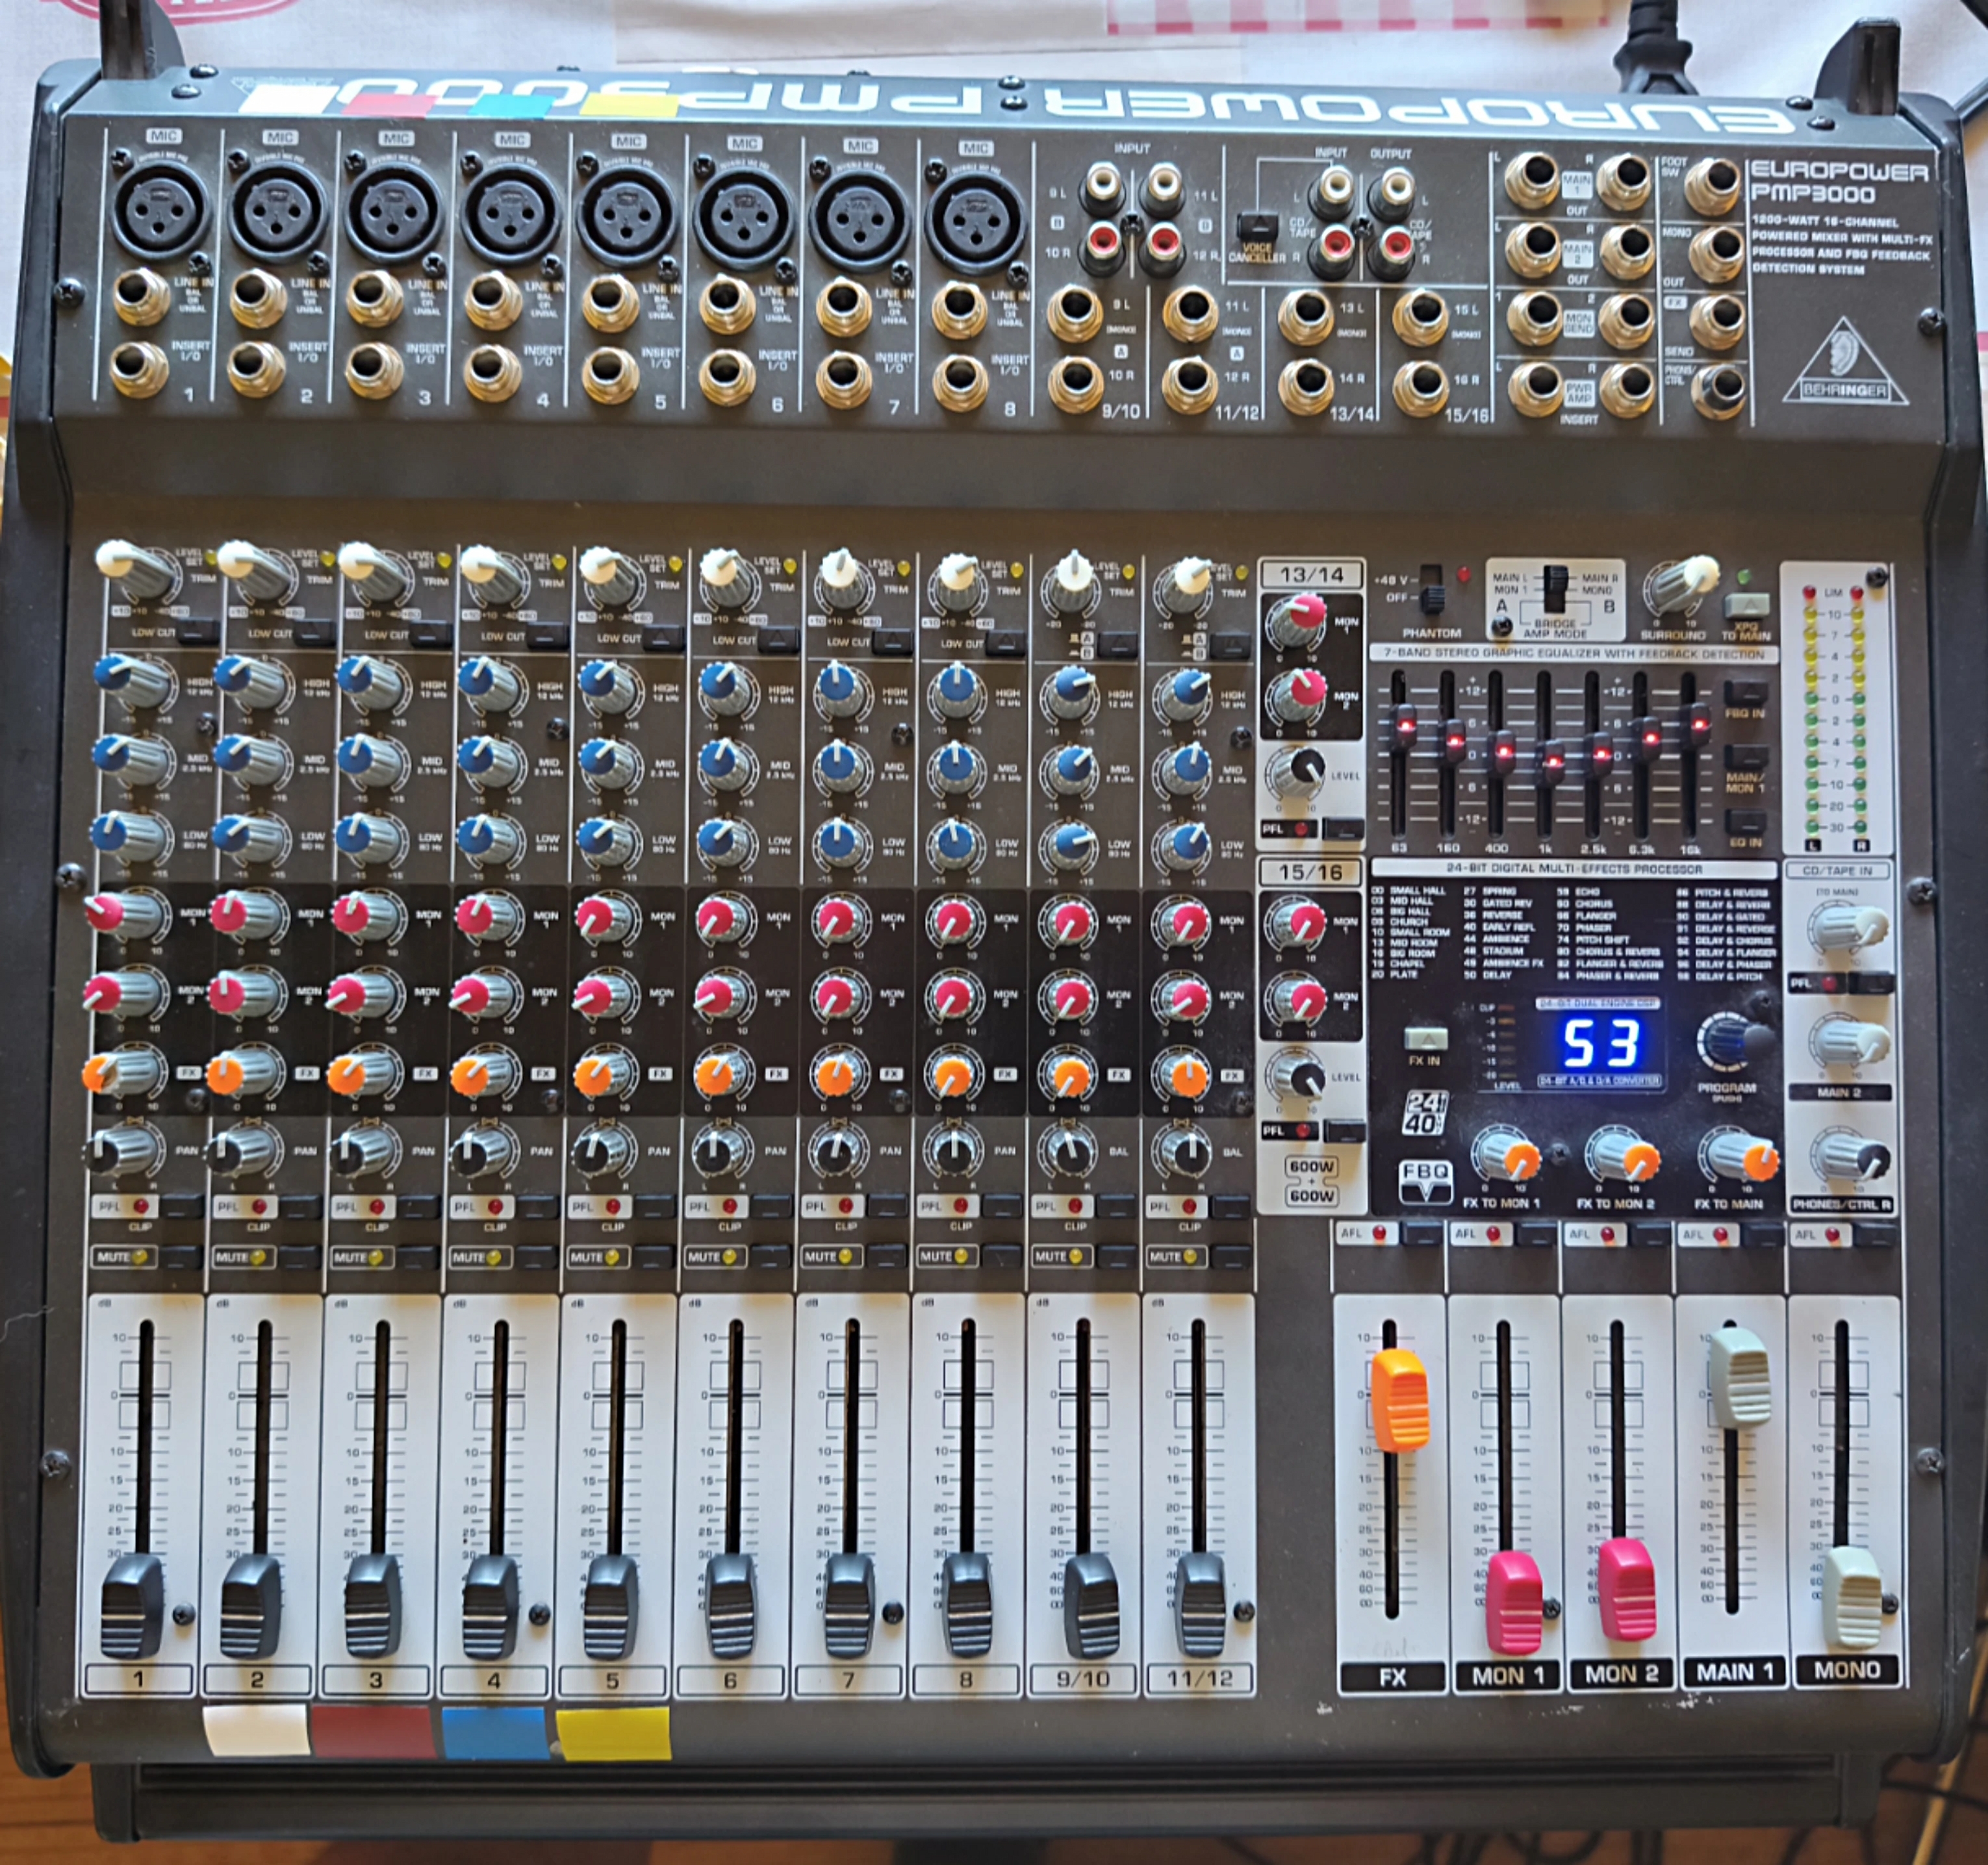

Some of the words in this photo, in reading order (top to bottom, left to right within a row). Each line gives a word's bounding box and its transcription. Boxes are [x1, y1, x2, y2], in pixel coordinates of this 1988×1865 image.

[1045, 89, 1796, 134] EUROPOWER
[151, 130, 177, 142] MIC
[268, 131, 294, 144] MIC
[385, 133, 409, 145] MIC
[500, 135, 526, 146] MIC
[617, 136, 642, 147] MIC
[732, 138, 758, 149] MIC
[848, 140, 873, 151] MIC
[964, 143, 989, 154] MIC
[1115, 144, 1151, 155] INPUT
[1315, 147, 1347, 159] INPUT
[1371, 149, 1412, 159] OUTPUT
[1661, 157, 1687, 166] FOOT
[1752, 160, 1929, 182] EUROPOWER
[1752, 184, 1875, 203] PMP3000
[1567, 207, 1588, 216] OUT
[1753, 214, 1819, 225] 1200-WATT
[1824, 216, 1899, 227] 16-CHANNEL
[1663, 229, 1691, 237] MONO
[1753, 231, 1808, 242] POWERED
[1812, 233, 1848, 242] MIXER
[1852, 234, 1877, 243] WITH
[1881, 235, 1933, 245] MULTI-FX
[1243, 243, 1273, 253] VOICE
[1753, 247, 1814, 258] PROCESSOR
[1817, 249, 1841, 258] AND
[1846, 249, 1867, 259] FBQ
[1872, 250, 1930, 260] FEEDBACK
[1229, 253, 1286, 263] CANCELLER
[1753, 262, 1815, 273] DETECTION
[1819, 265, 1865, 275] SYSTEM
[1568, 275, 1588, 284] OUT
[1663, 277, 1684, 286] OUT
[172, 341, 210, 351] INSERT
[642, 348, 680, 358] INSERT
[1664, 348, 1694, 356] SEND
[185, 389, 193, 401] 1
[1805, 383, 1885, 396] BEHRINGER
[301, 390, 312, 403] 2
[419, 392, 431, 405] 3
[537, 396, 549, 407] 4
[655, 396, 667, 409] 5
[772, 398, 784, 412] 6
[889, 400, 900, 414] 7
[1004, 403, 1016, 416] 8
[1102, 404, 1140, 419] 9/10
[1216, 406, 1260, 420] 11/12
[1331, 407, 1374, 421] 13/14
[1445, 409, 1488, 423] 15/16
[1560, 415, 1598, 424] INSERT
[1281, 568, 1344, 583] 13/14
[771, 583, 795, 592] TRIM
[1825, 589, 1842, 597] LIM
[1386, 594, 1407, 602] OFF
[1496, 600, 1507, 613] A
[1604, 600, 1614, 613] B
[1535, 619, 1575, 628] BRIDGE
[481, 633, 503, 641] LOW
[507, 633, 525, 641] CUT
[1403, 629, 1461, 638] PHANTOM
[1524, 629, 1549, 638] AMP
[1554, 629, 1587, 639] MODE
[1641, 631, 1706, 640] SURROUND
[1722, 631, 1735, 641] TO
[1740, 631, 1771, 641] MAIN
[1385, 648, 1429, 657] 7-BAND
[1435, 648, 1479, 657] STEREO
[1483, 649, 1535, 658] GRAPHIC
[1544, 649, 1600, 658] EQUALIZER
[1605, 649, 1635, 658] WITH
[1639, 650, 1698, 659] FEEDBACK
[1703, 650, 1765, 659] DETECTION
[537, 683, 563, 691] HIGH
[1726, 709, 1748, 719] FBQ
[1750, 709, 1765, 718] IN
[539, 759, 559, 767] MID
[1727, 774, 1765, 783] MAIN/
[1727, 783, 1754, 793] MON
[1759, 784, 1765, 793] 1
[536, 835, 559, 843] LOW
[1730, 839, 1746, 847] EQ
[1748, 839, 1762, 847] IN
[1279, 865, 1343, 880] 15/16
[1447, 864, 1487, 872] 24-BIT
[1492, 864, 1535, 872] DIGITAL
[1635, 865, 1703, 874] PROCESSOR
[1803, 867, 1854, 875] CD/TAPE
[1859, 867, 1873, 875] IN
[417, 911, 441, 920] MON
[1390, 971, 1418, 979] PLATE
[650, 989, 674, 998] MON
[1565, 1019, 1639, 1067] 53
[1409, 1056, 1423, 1065] FX
[1427, 1056, 1440, 1065] IN
[1699, 1084, 1757, 1093] PROGRAM
[1818, 1089, 1849, 1098] MAIN
[1853, 1089, 1862, 1098] 2
[1409, 1095, 1439, 1112] 24
[1406, 1115, 1435, 1133] 40
[765, 1147, 787, 1156] PAN
[1110, 1147, 1129, 1156] BAL
[1290, 1161, 1334, 1172] 600W
[1404, 1164, 1448, 1178] FBQ
[1290, 1190, 1334, 1202] 600W
[99, 1202, 120, 1212] PFL
[1464, 1199, 1478, 1208] FX
[1483, 1199, 1497, 1208] TO
[1501, 1199, 1527, 1208] MON
[1534, 1199, 1540, 1208] 1
[1794, 1199, 1879, 1210] PHONES/CTRL
[1881, 1200, 1892, 1210] R
[602, 1223, 624, 1232] CLIP
[217, 1253, 248, 1262] MUTE
[921, 1251, 952, 1261] MUTE
[1585, 1665, 1637, 1683] MON
[1646, 1665, 1659, 1683] 2
[1697, 1662, 1753, 1681] MAIN
[1763, 1662, 1773, 1681] 1
[1814, 1660, 1881, 1679] MONO
[134, 1670, 143, 1688] 1
[251, 1671, 263, 1688] 2
[370, 1672, 383, 1689] 3
[487, 1672, 501, 1689] 4
[607, 1672, 619, 1689] 5
[724, 1671, 737, 1689] 6
[843, 1671, 855, 1689] 7
[960, 1671, 973, 1689] 8
[1057, 1669, 1110, 1689] 9/10
[1167, 1669, 1233, 1688] 11/12
[1380, 1667, 1405, 1686] FX
[1473, 1668, 1524, 1685] MON
[1535, 1668, 1544, 1685] 1
